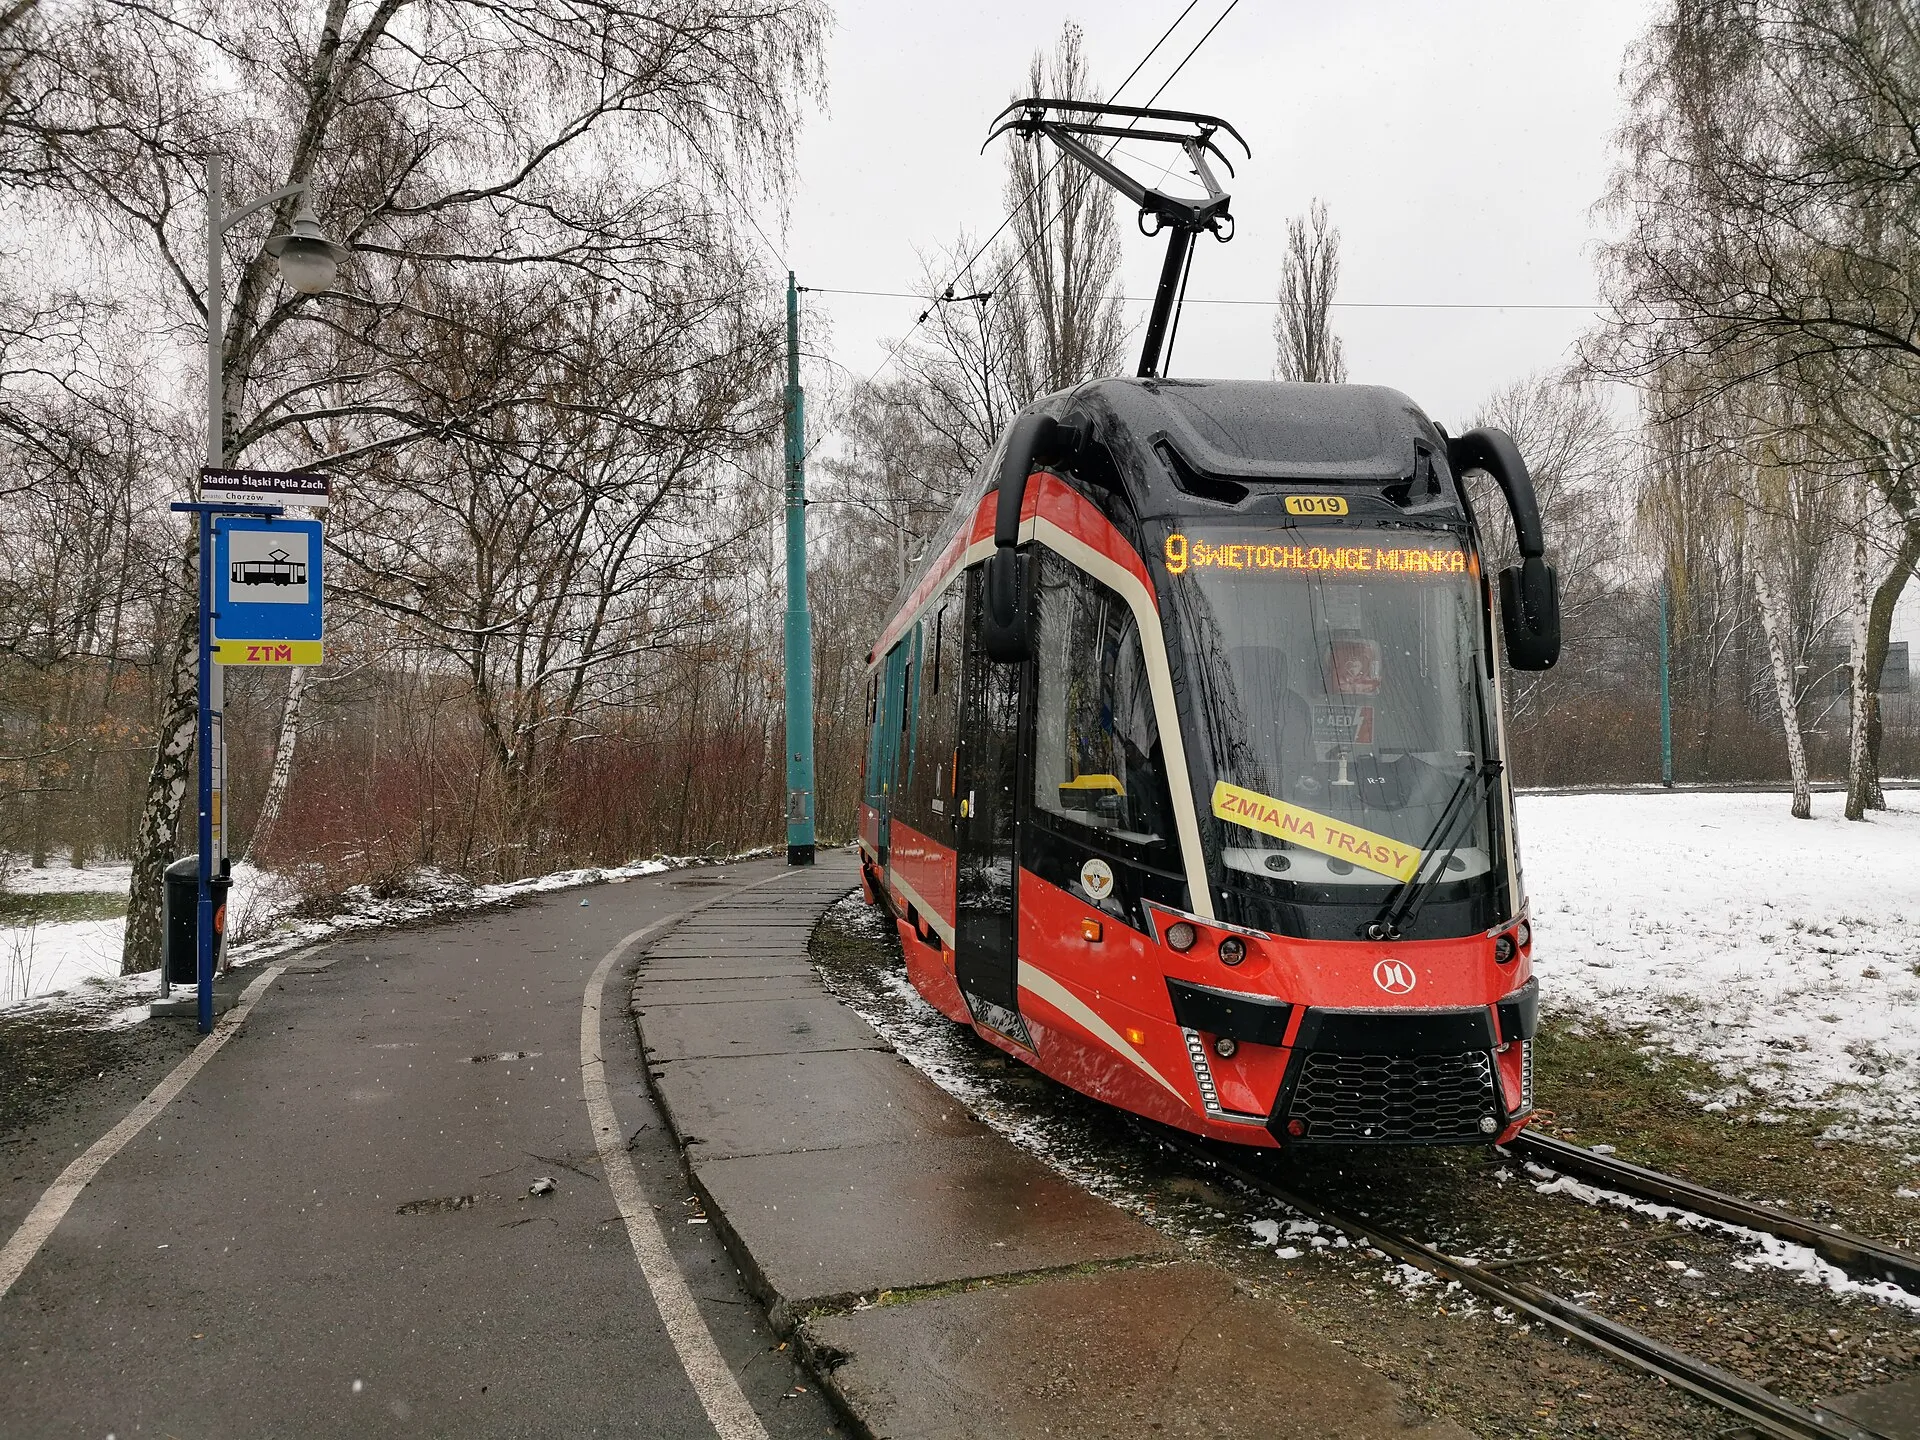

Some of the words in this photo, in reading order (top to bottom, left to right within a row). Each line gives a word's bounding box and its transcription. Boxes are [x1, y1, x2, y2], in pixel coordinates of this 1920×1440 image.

[203, 475, 239, 485] Stadion
[242, 475, 271, 487] Śląski
[274, 479, 298, 489] Pętla
[301, 480, 326, 489] Zach.
[226, 492, 264, 501] Chorzów
[1293, 498, 1341, 513] 1019
[1165, 534, 1188, 575] 9
[1192, 540, 1372, 570] ŚWIĘTOCHŁOWICE
[1376, 549, 1465, 573] MIJANKA
[246, 644, 292, 662] ZTM
[1327, 715, 1352, 727] AED
[1220, 793, 1315, 840] ZMIANA
[1325, 828, 1408, 869] TRASY
